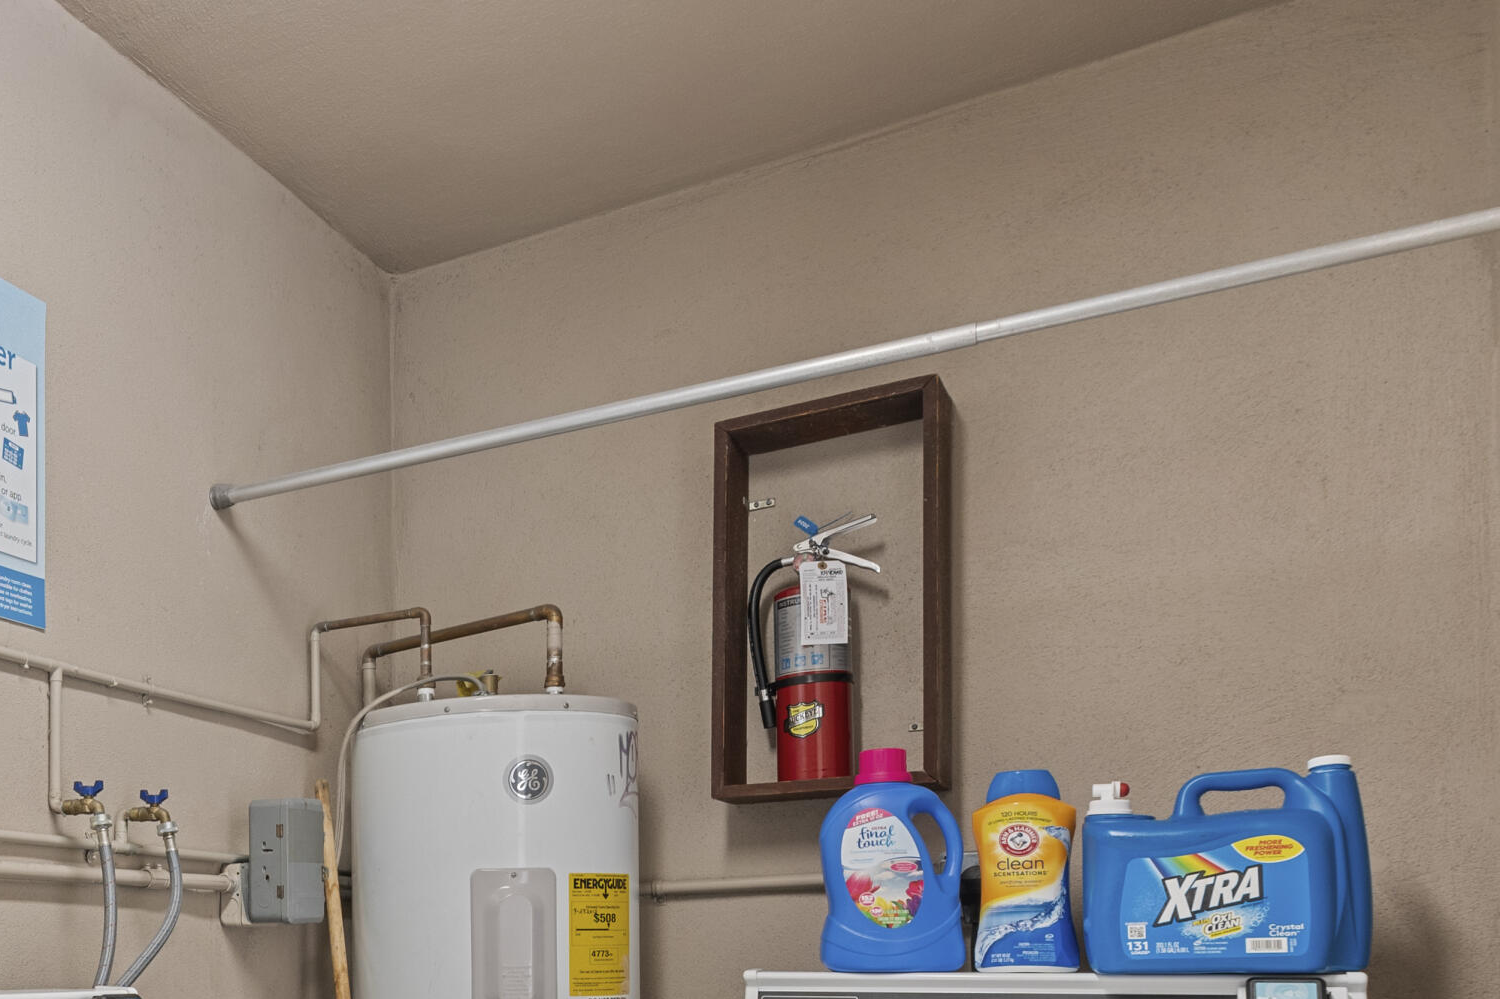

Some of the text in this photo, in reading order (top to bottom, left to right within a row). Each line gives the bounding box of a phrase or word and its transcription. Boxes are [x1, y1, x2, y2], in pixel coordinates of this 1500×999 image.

[856, 810, 879, 821] FREE!
[860, 825, 895, 840] final
[858, 836, 896, 849] touch
[997, 858, 1044, 870] clean
[1153, 864, 1264, 927] XTRA
[593, 913, 616, 923] $508
[1212, 912, 1232, 923] OXI
[1204, 917, 1241, 933] CLEAN
[1269, 923, 1304, 931] Crystal
[1127, 941, 1148, 950] 131
